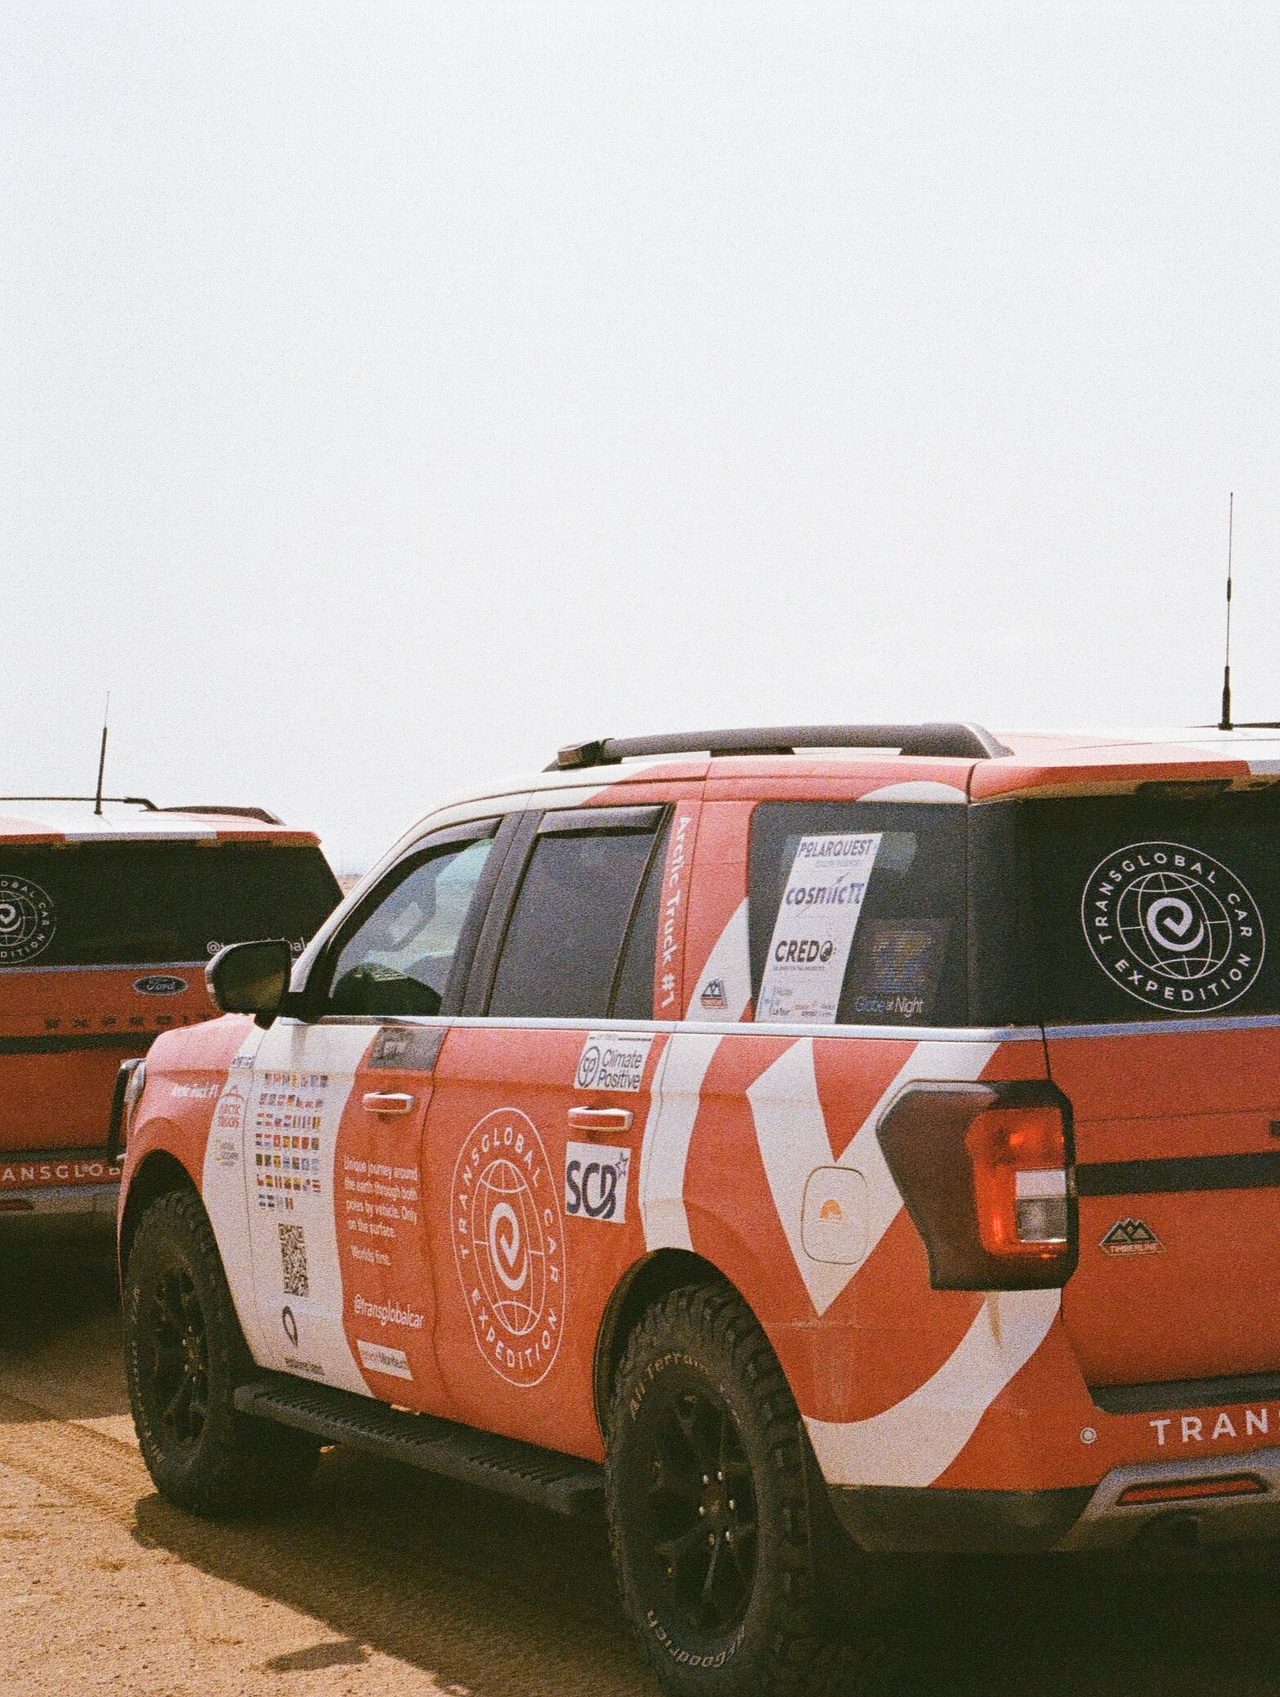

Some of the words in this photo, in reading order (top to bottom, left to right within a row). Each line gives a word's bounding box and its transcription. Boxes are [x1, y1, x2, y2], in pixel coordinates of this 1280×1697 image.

[669, 816, 692, 887] Arctic
[38, 902, 50, 926] CAR
[1095, 852, 1217, 944] TRANSGLOBAL
[1227, 893, 1253, 937] CAR
[662, 890, 681, 965] Truck
[774, 940, 834, 962] CREDO
[661, 973, 676, 1008] #1
[1114, 953, 1252, 1001] EXPEDITION
[895, 997, 924, 1017] Night
[602, 1049, 643, 1068] Climate
[596, 1069, 640, 1089] Positive
[458, 1127, 541, 1259] TRANSGLOBAL
[543, 1209, 559, 1283] CAR
[354, 1293, 424, 1329] @transglobalcar
[471, 1288, 558, 1369] EXPEDITION
